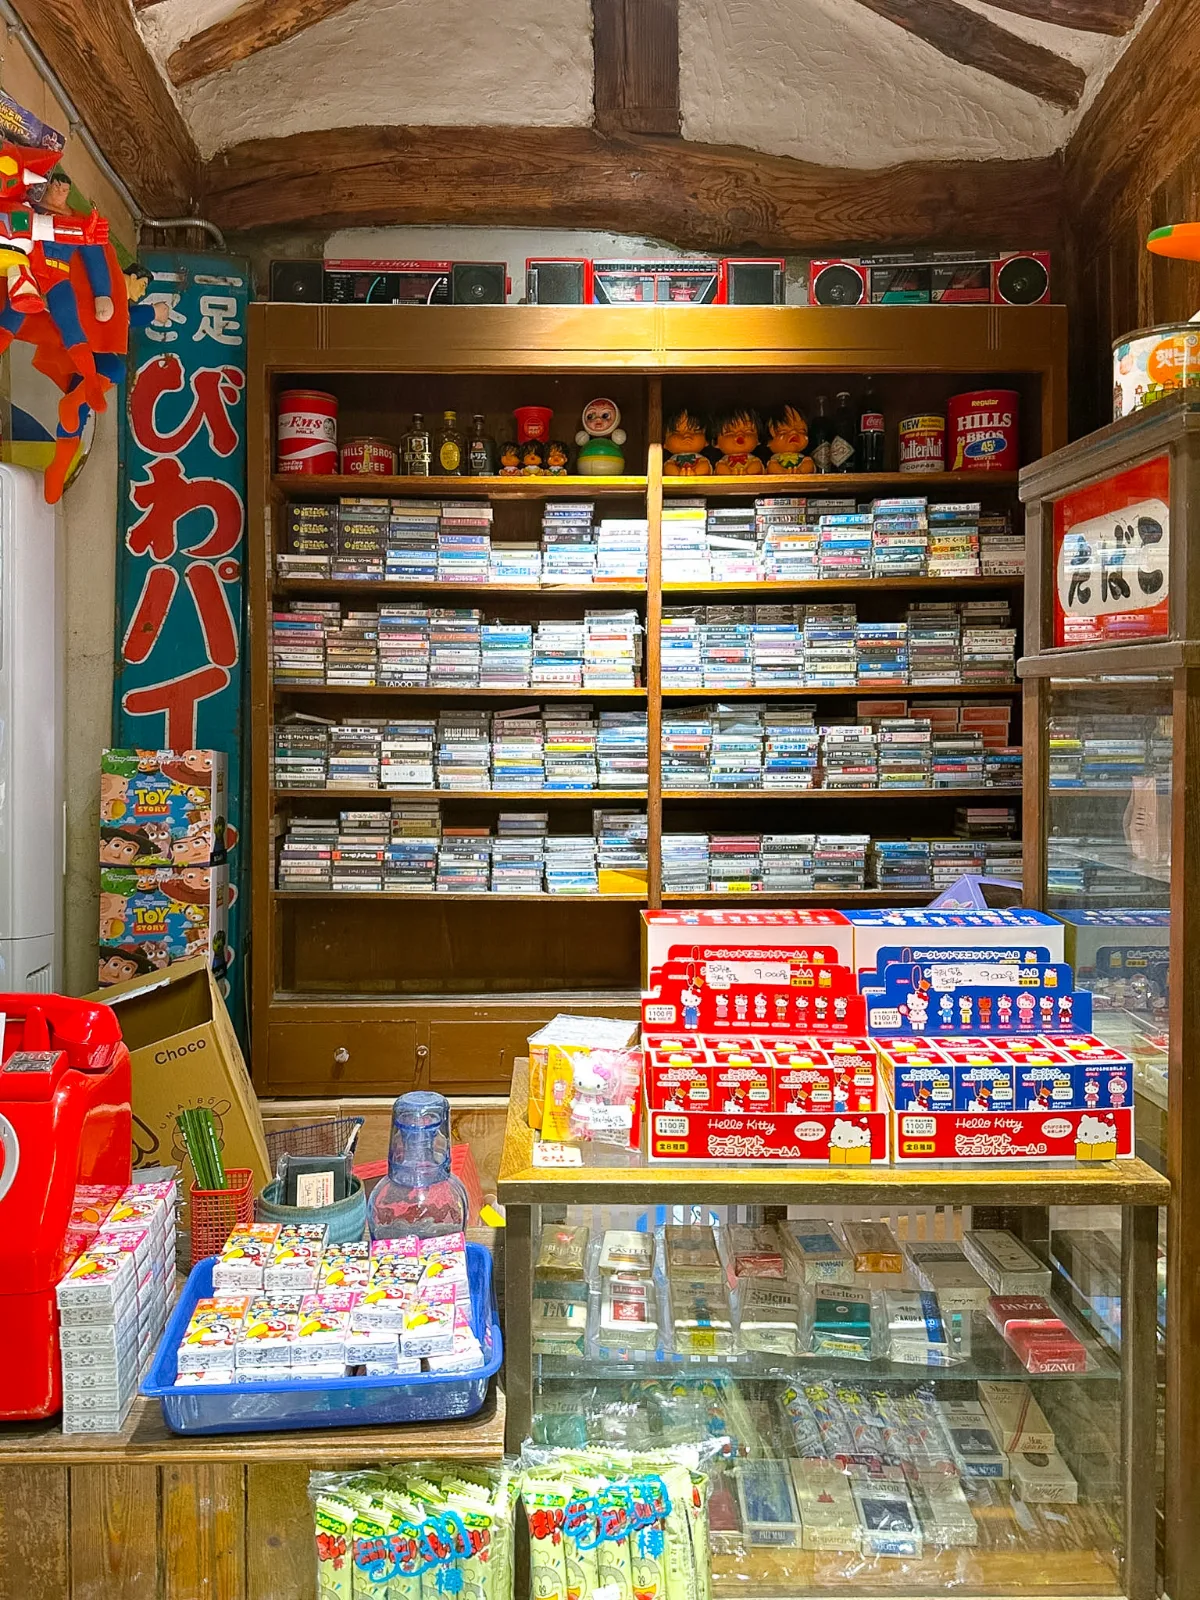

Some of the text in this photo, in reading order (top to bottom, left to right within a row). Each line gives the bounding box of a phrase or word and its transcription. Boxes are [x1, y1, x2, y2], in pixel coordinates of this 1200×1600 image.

[971, 399, 999, 407] Regular
[902, 418, 920, 430] NEW
[956, 412, 1012, 432] HILLS
[343, 446, 393, 459] HILLS BROS
[134, 789, 174, 806] TOY
[137, 805, 168, 813] STORY
[132, 907, 172, 925] TOY
[154, 1038, 207, 1066] Choco
[659, 1122, 686, 1130] 1100円
[707, 1118, 777, 1134] Hello Kitty
[905, 1122, 933, 1130] 1100円
[955, 1117, 1024, 1134] Hello Kitty
[708, 1135, 764, 1146] シークレット
[955, 1135, 1011, 1145] シークレット
[659, 1143, 686, 1151] 全8種類
[708, 1145, 801, 1157] マスコットチャームA
[905, 1143, 934, 1151] 全8種類
[956, 1144, 1047, 1155] マスコットチャームB
[608, 1247, 648, 1255] CASTER
[751, 1291, 792, 1304] Salem
[820, 1288, 865, 1300] Carlton
[1000, 1302, 1049, 1312] DANZIG
[894, 1313, 923, 1323] SAKURA
[1039, 1362, 1076, 1373] DANZIG
